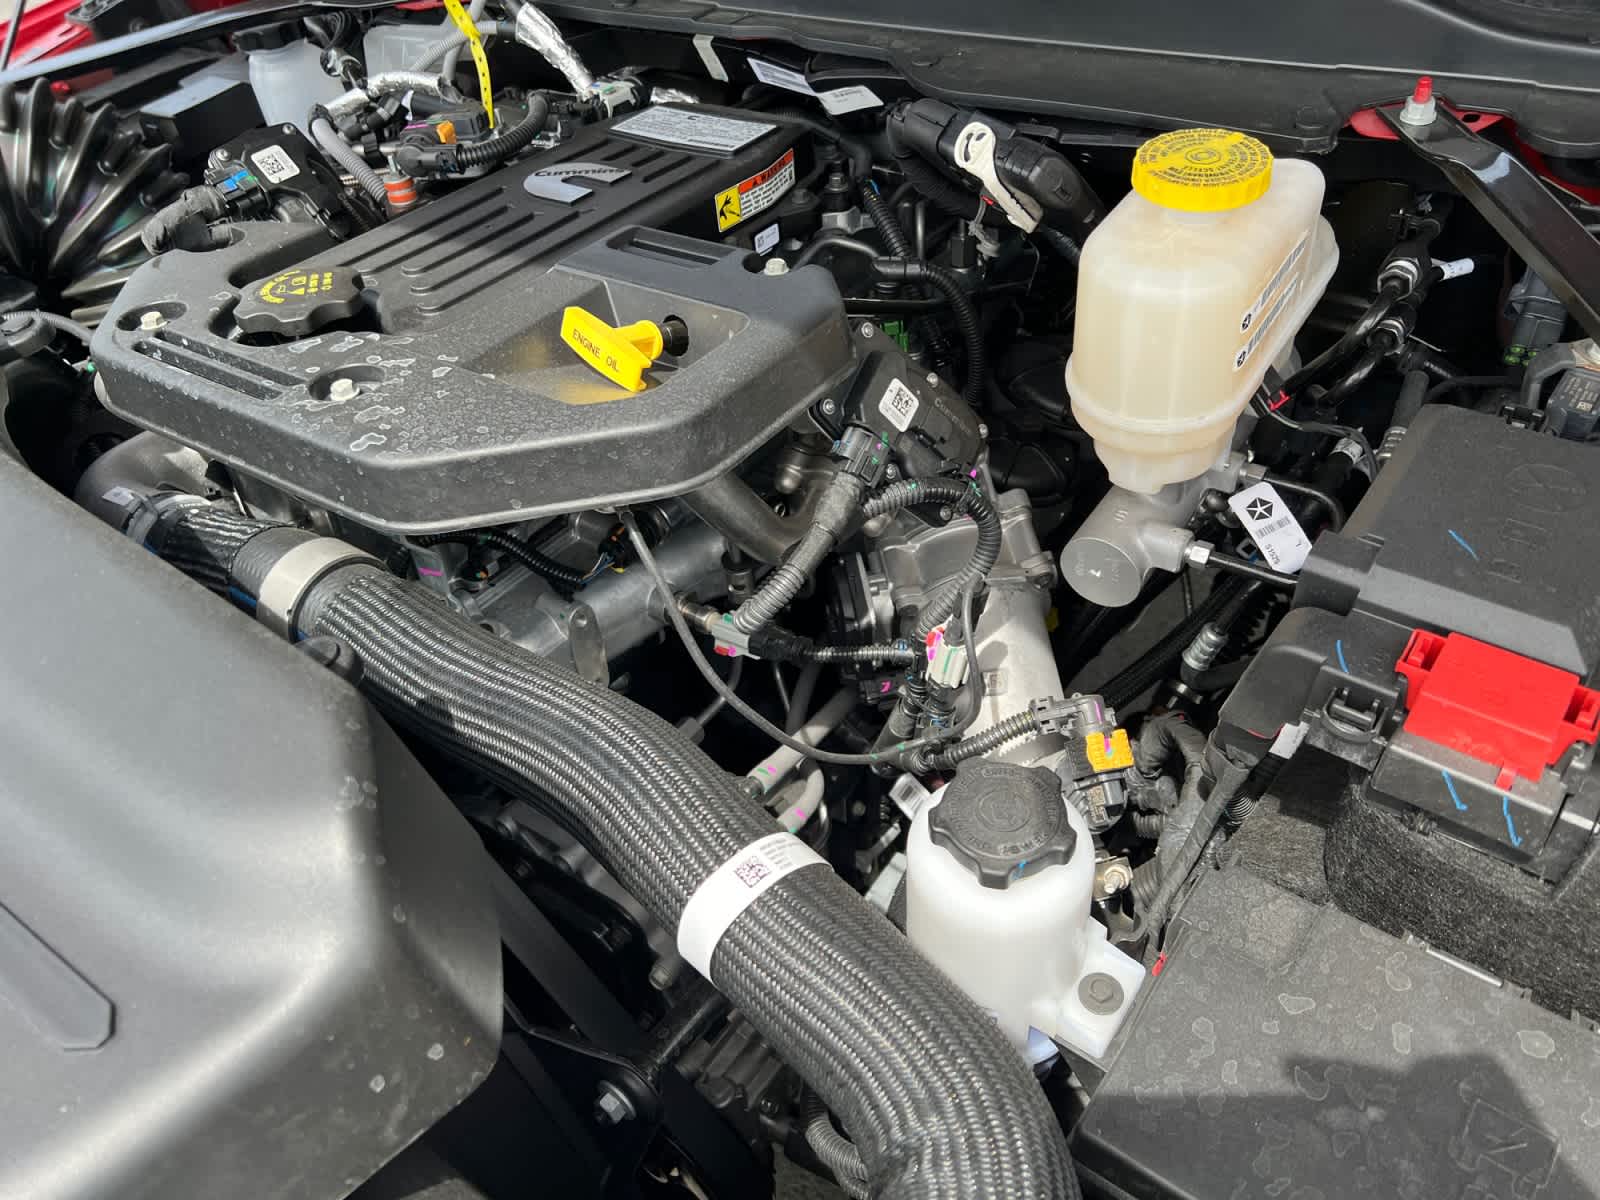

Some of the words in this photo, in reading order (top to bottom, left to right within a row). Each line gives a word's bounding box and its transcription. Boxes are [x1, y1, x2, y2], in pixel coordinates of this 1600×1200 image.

[534, 167, 627, 177] Cummins
[572, 328, 600, 358] ENGINE
[606, 356, 619, 372] OIL
